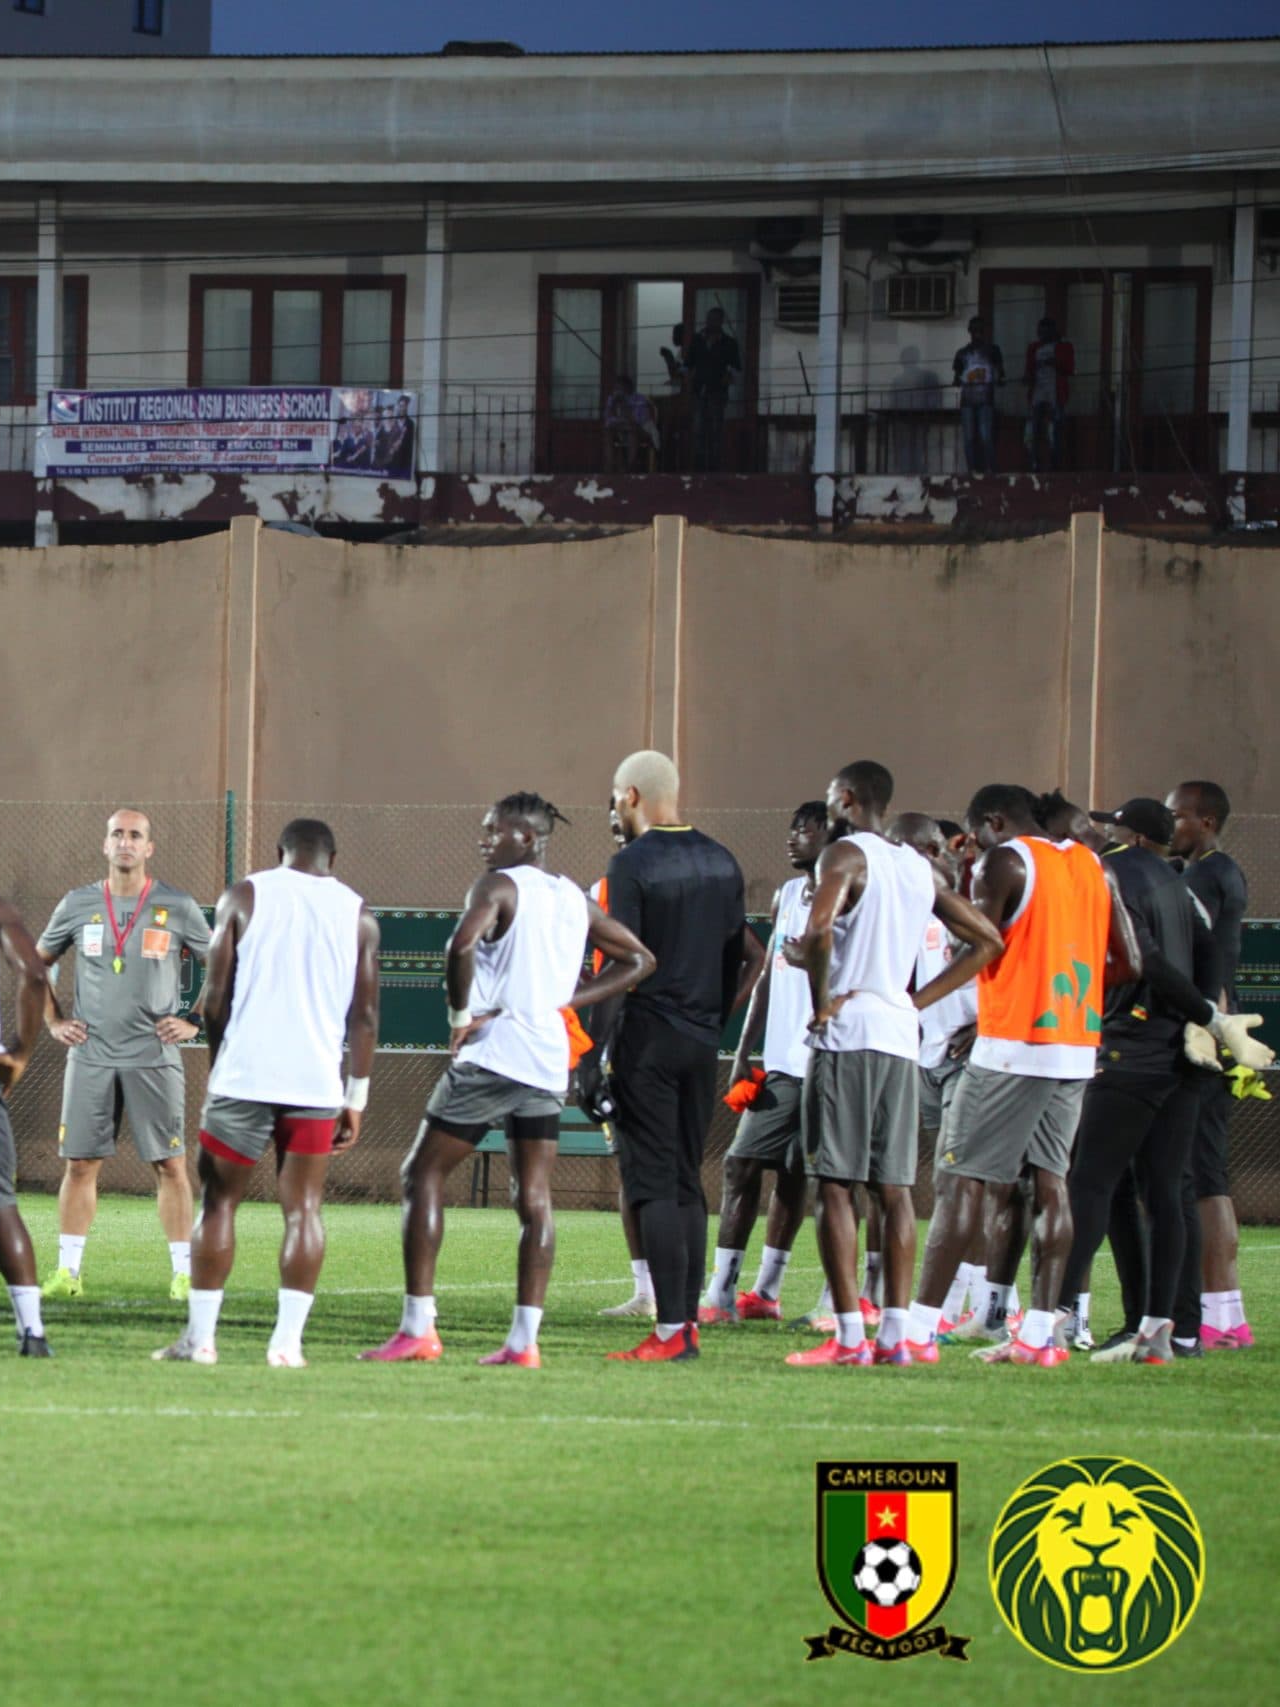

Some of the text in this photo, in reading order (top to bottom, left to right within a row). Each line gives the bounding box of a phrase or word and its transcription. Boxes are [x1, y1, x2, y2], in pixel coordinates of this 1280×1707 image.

[83, 393, 329, 422] INSTITUT REGIONAL DSM BUSINESS SCHOOL
[81, 442, 147, 452] SEMINAIRES
[282, 440, 298, 450] RH
[87, 453, 120, 464] Cours
[126, 452, 140, 463] du
